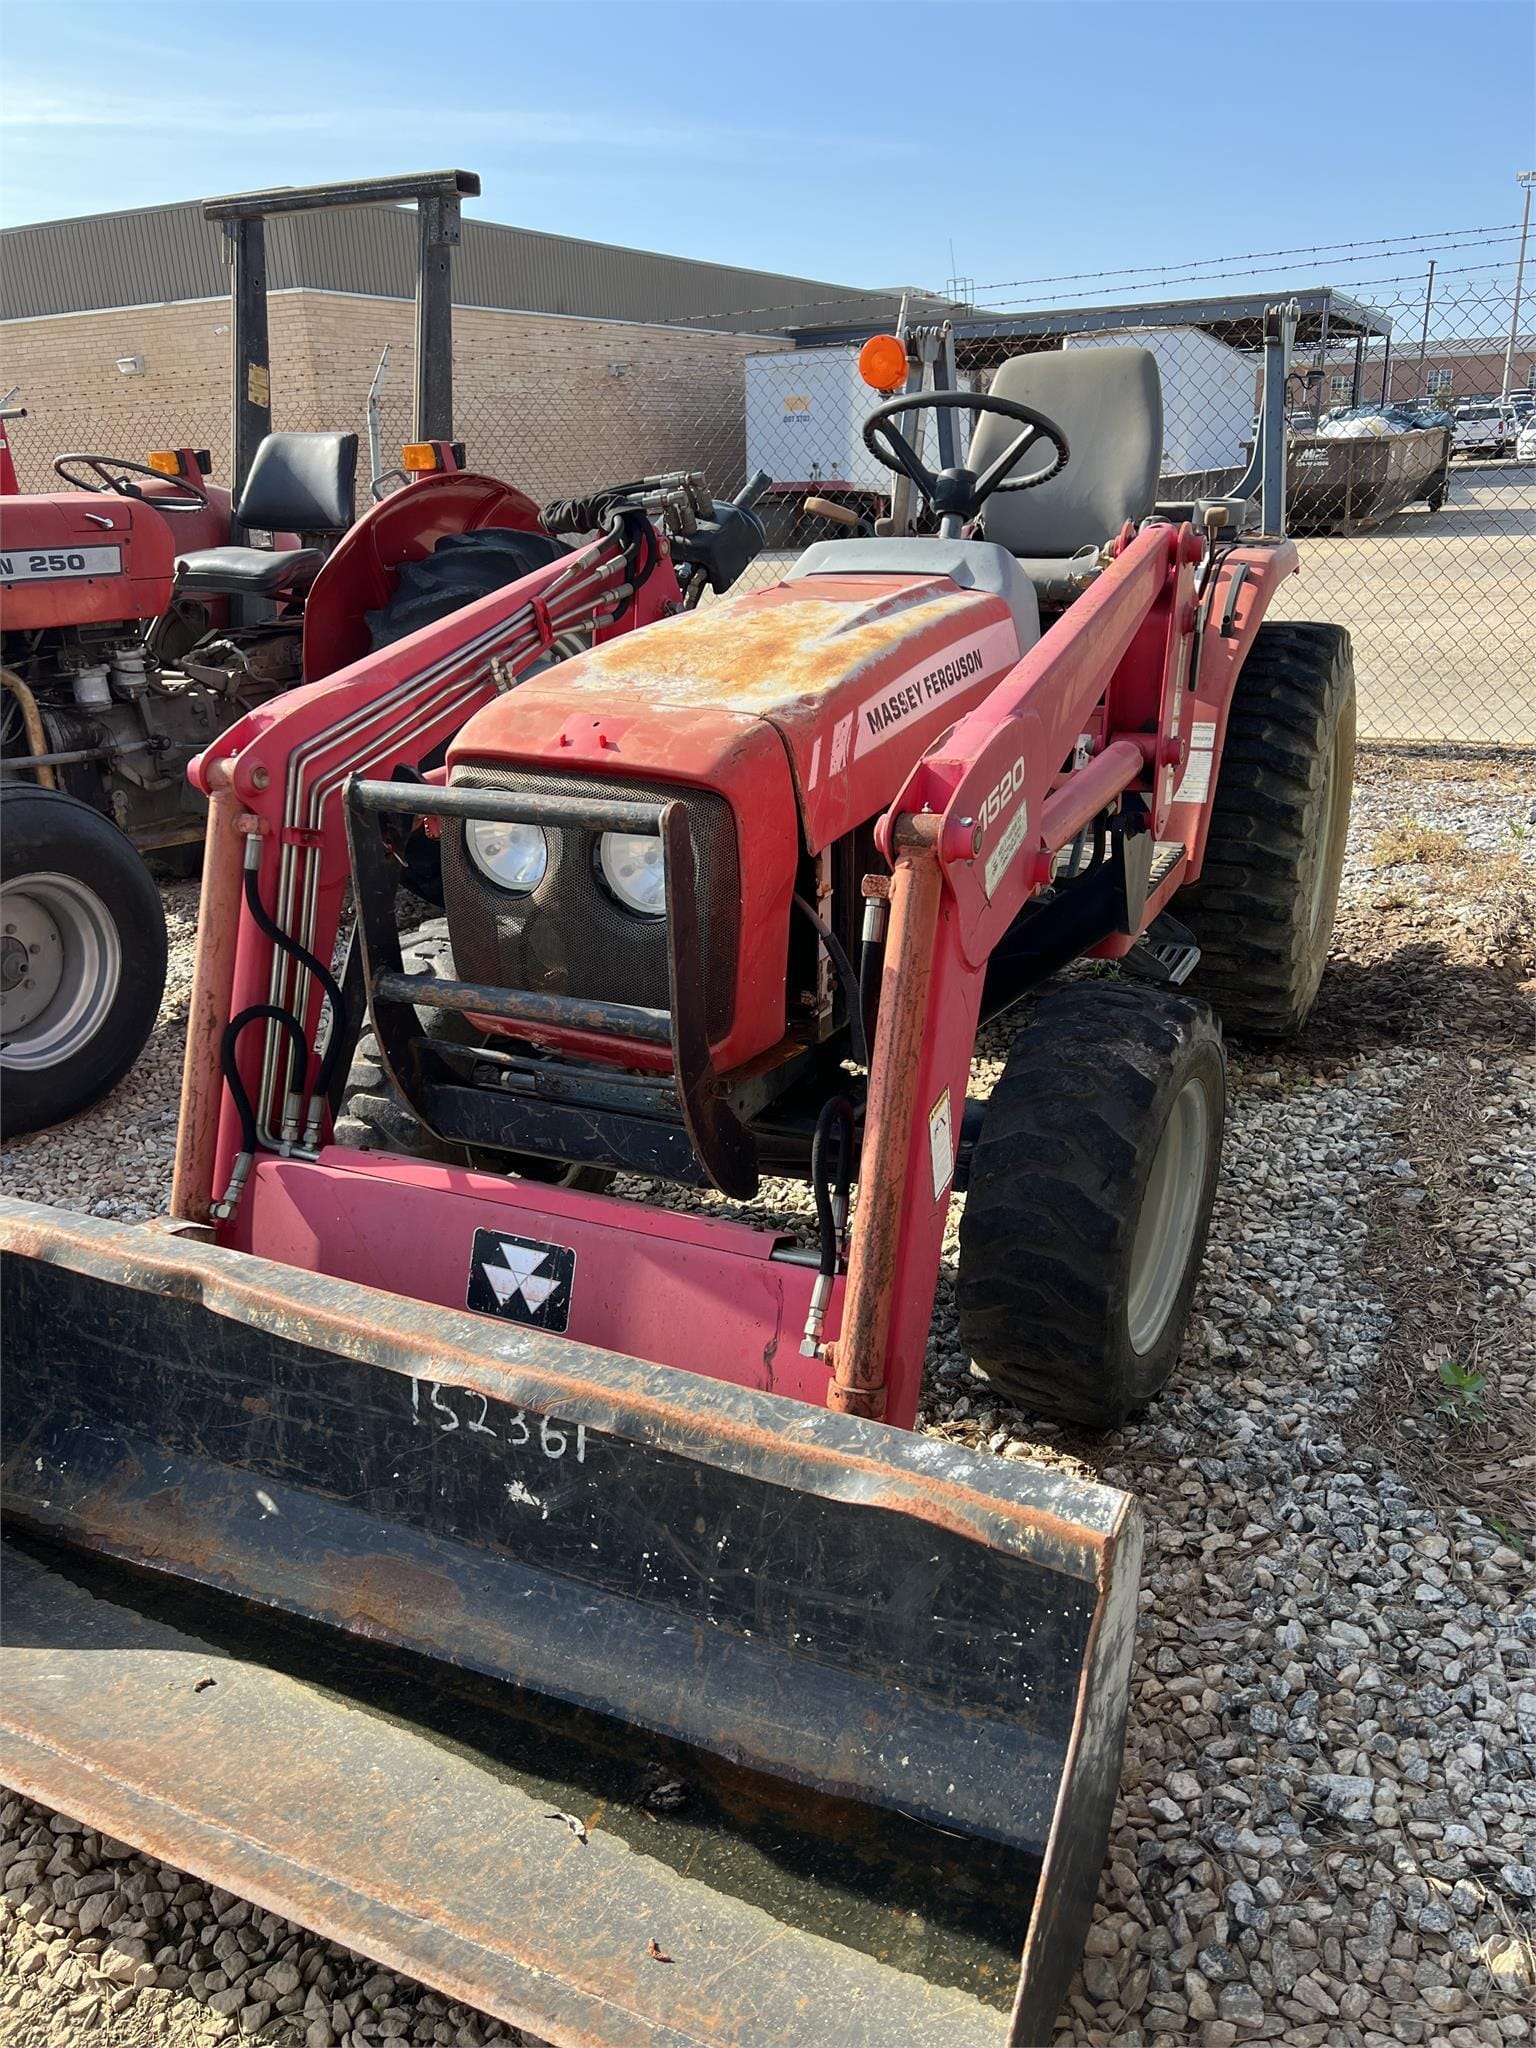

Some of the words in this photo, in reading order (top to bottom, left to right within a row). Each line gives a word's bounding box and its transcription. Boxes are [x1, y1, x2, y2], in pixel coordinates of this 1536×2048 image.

[28, 554, 86, 572] 250
[866, 681, 924, 735] MASSEY
[923, 648, 983, 699] FERGUSON
[978, 755, 1025, 832] 1520
[411, 1377, 586, 1464] 152361
